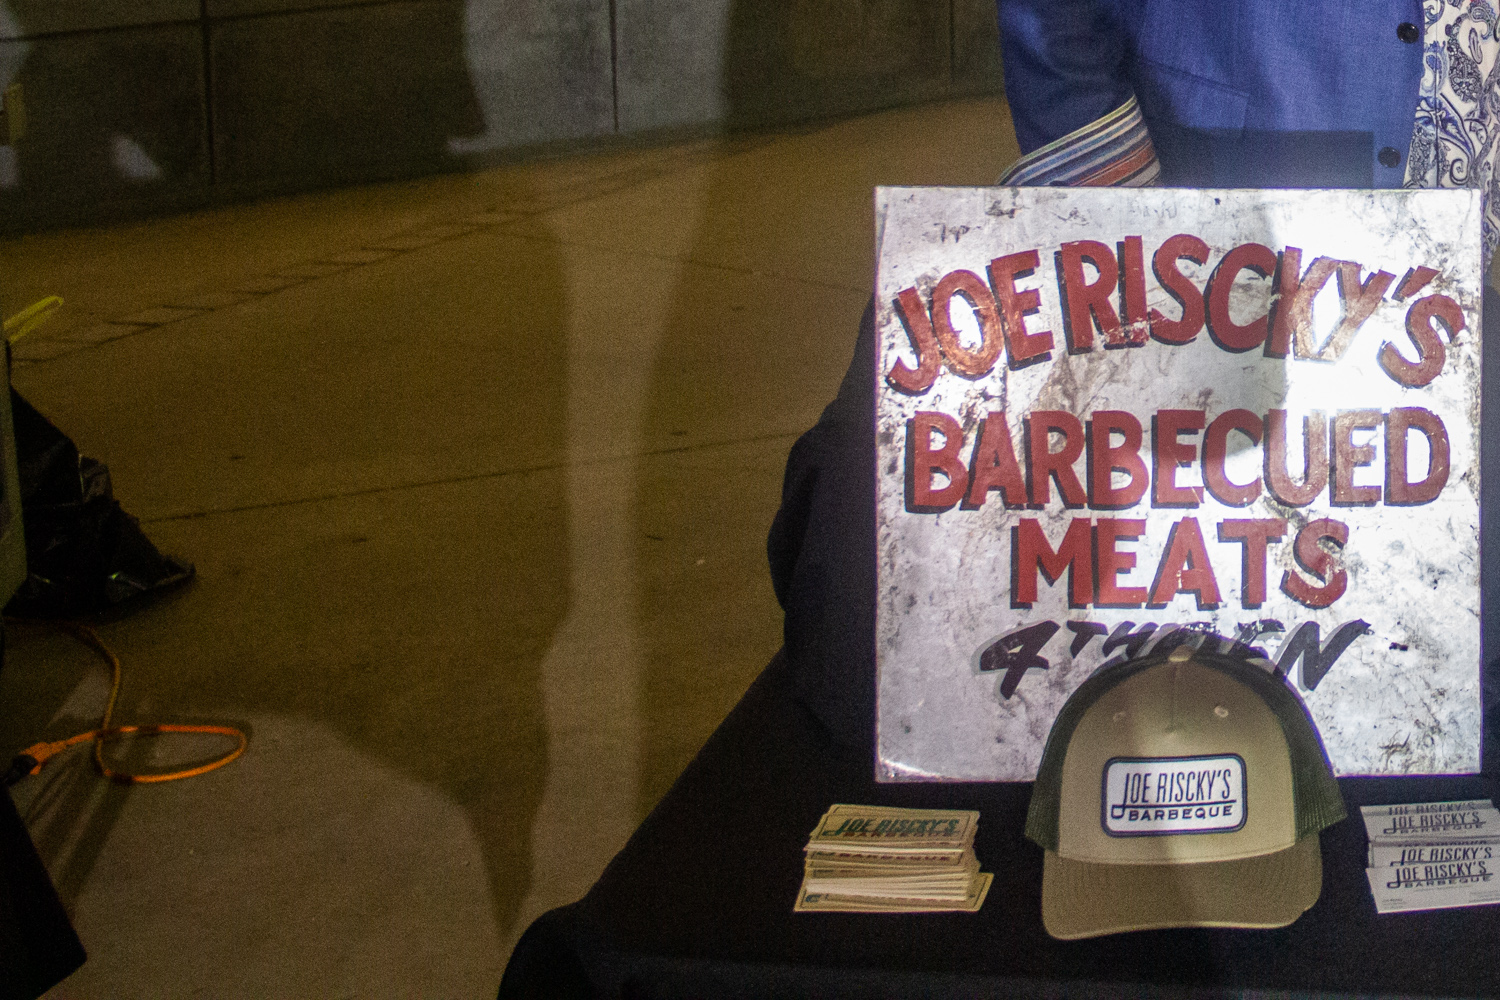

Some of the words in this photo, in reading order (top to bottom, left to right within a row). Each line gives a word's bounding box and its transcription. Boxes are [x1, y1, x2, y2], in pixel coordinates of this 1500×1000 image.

[884, 248, 1055, 397] JOE
[1055, 233, 1466, 389] RISCKY'S
[904, 406, 1451, 513] BARBECUED
[1010, 516, 1350, 611] MEATS
[1111, 772, 1152, 819] JOE
[1156, 768, 1232, 803] RISCKY'S
[1128, 805, 1233, 822] BARBEQUE
[1383, 814, 1414, 834] JOE
[1420, 811, 1480, 828] RISCKY'S
[822, 818, 877, 837] JOE
[878, 818, 961, 837] RISCKY'S
[1400, 822, 1484, 834] BARBEQUE
[1390, 849, 1425, 867] JOE
[1429, 846, 1493, 862] RISCKY'S
[1387, 868, 1418, 889] JOE
[1424, 860, 1488, 880] RISCKY'S
[1404, 875, 1492, 889] BARBEQUE
